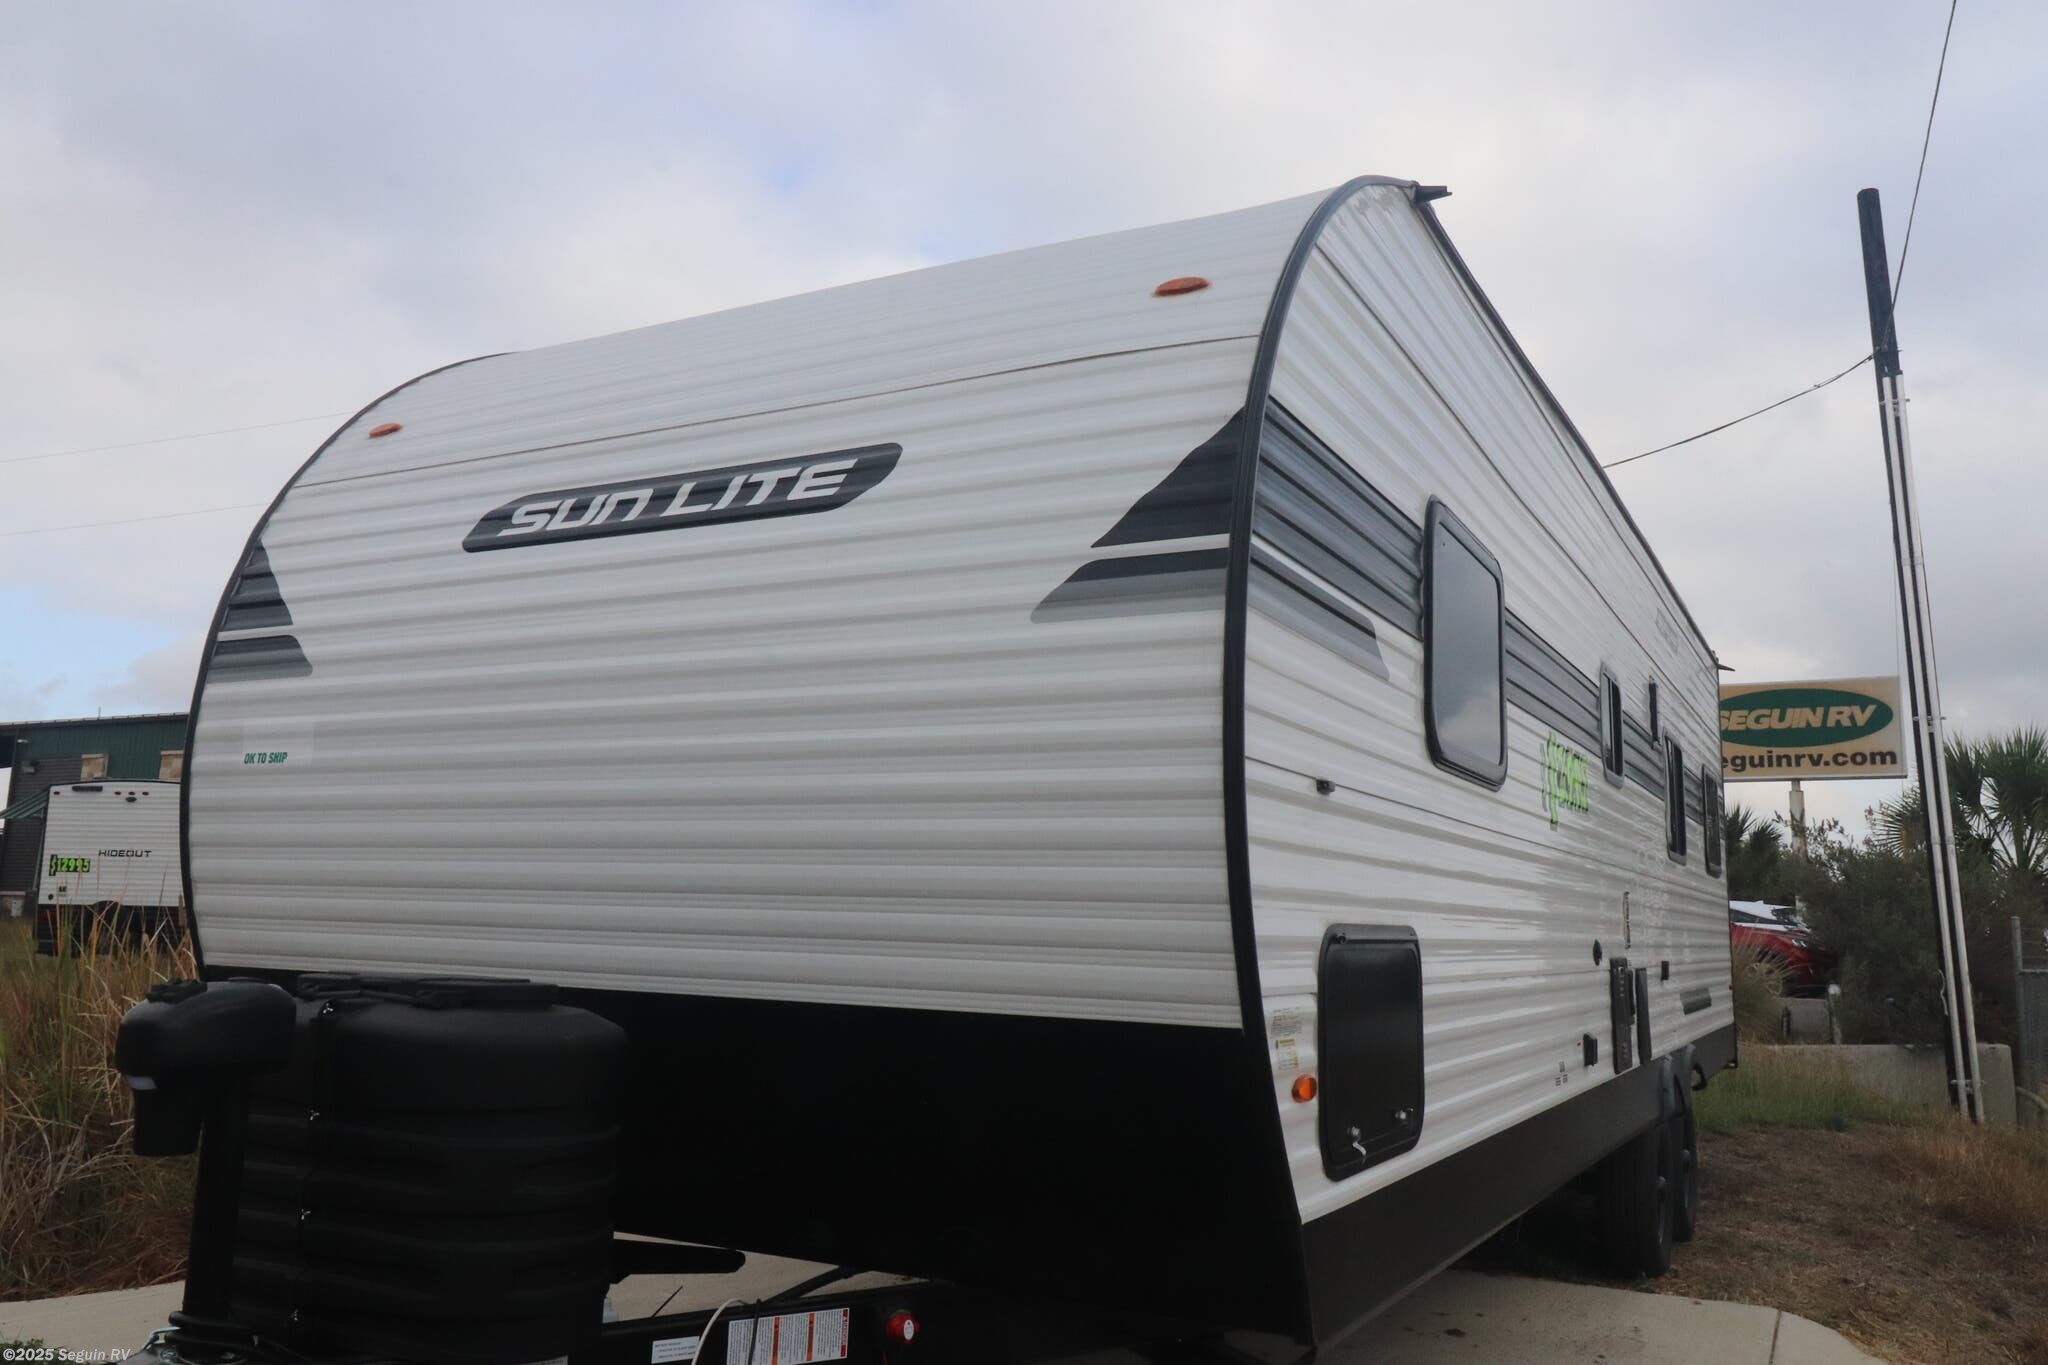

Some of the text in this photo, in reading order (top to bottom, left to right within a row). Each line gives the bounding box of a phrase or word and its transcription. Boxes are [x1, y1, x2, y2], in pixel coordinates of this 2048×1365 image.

[497, 458, 859, 537] SUN LITE
[1720, 704, 1878, 732] SEGUIN RV
[243, 751, 288, 765] OK TO SHIP
[98, 849, 152, 858] HIDEOUT
